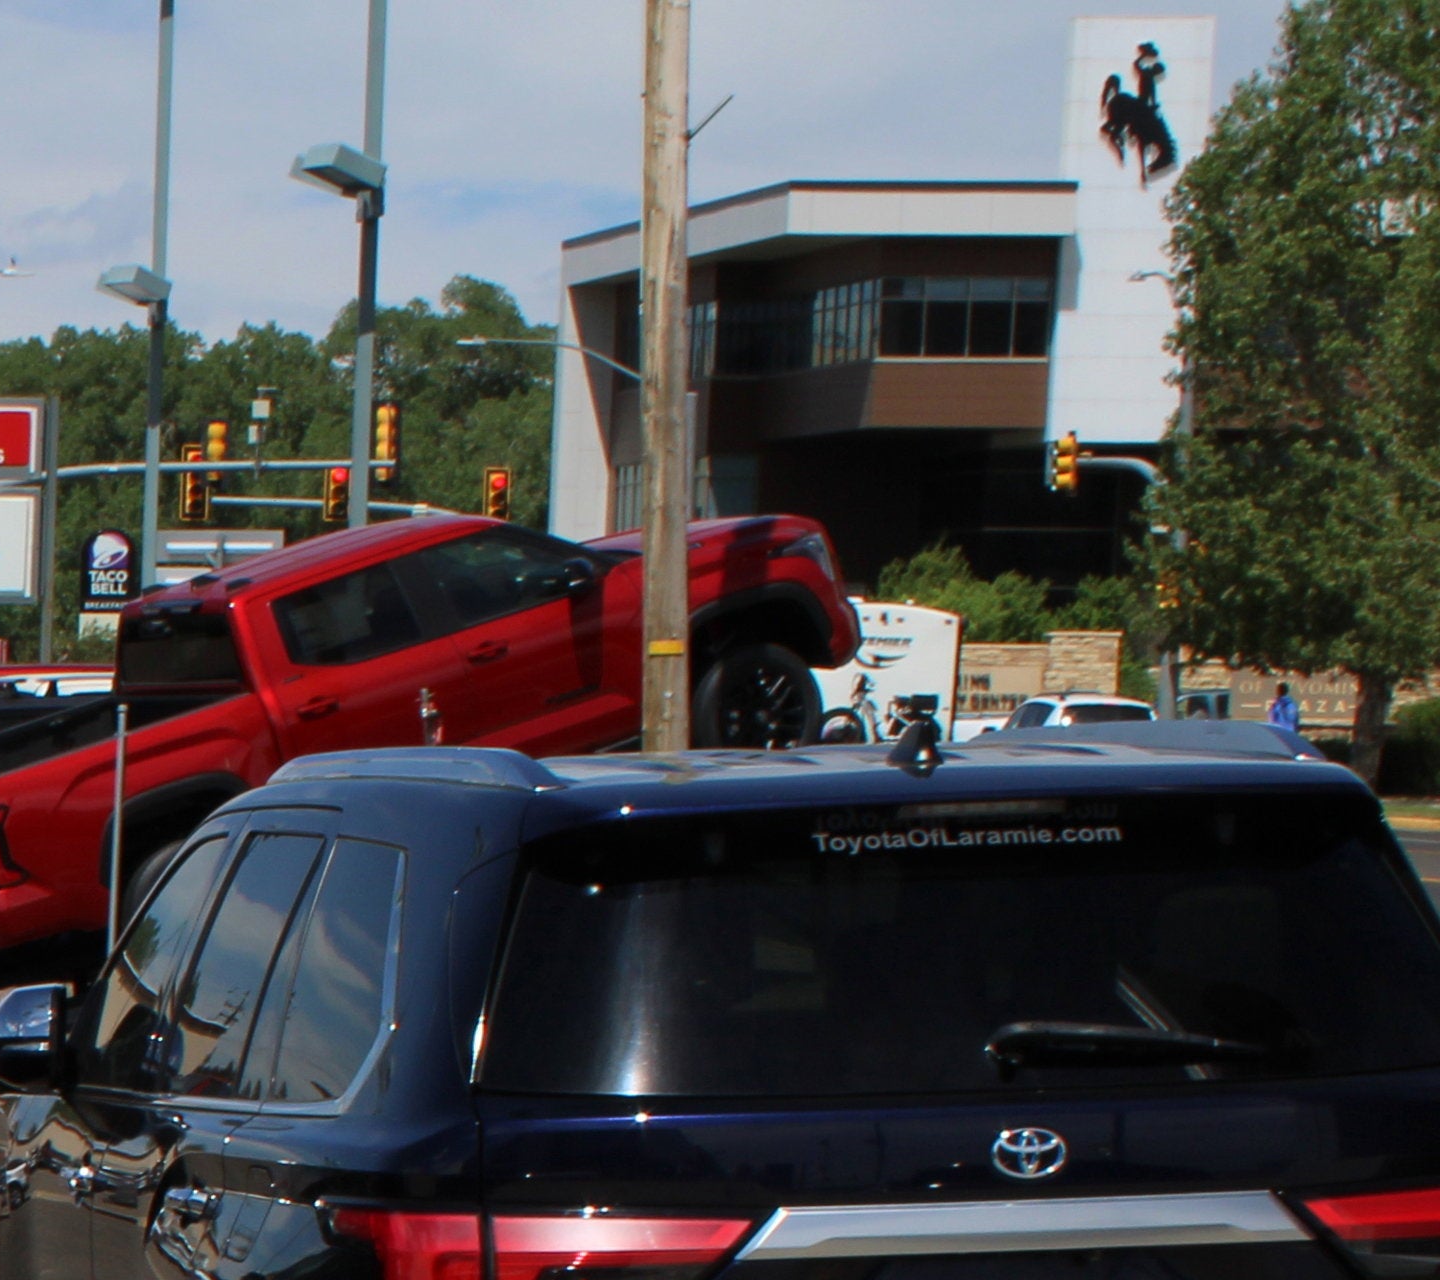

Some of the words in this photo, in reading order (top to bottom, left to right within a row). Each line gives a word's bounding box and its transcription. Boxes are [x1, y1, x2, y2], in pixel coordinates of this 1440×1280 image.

[88, 570, 128, 583] TACO
[90, 582, 127, 595] BELL
[1239, 681, 1263, 694] OF
[1266, 699, 1346, 713] PAZA
[812, 825, 1122, 855] ToyotaOfLaramie.com
